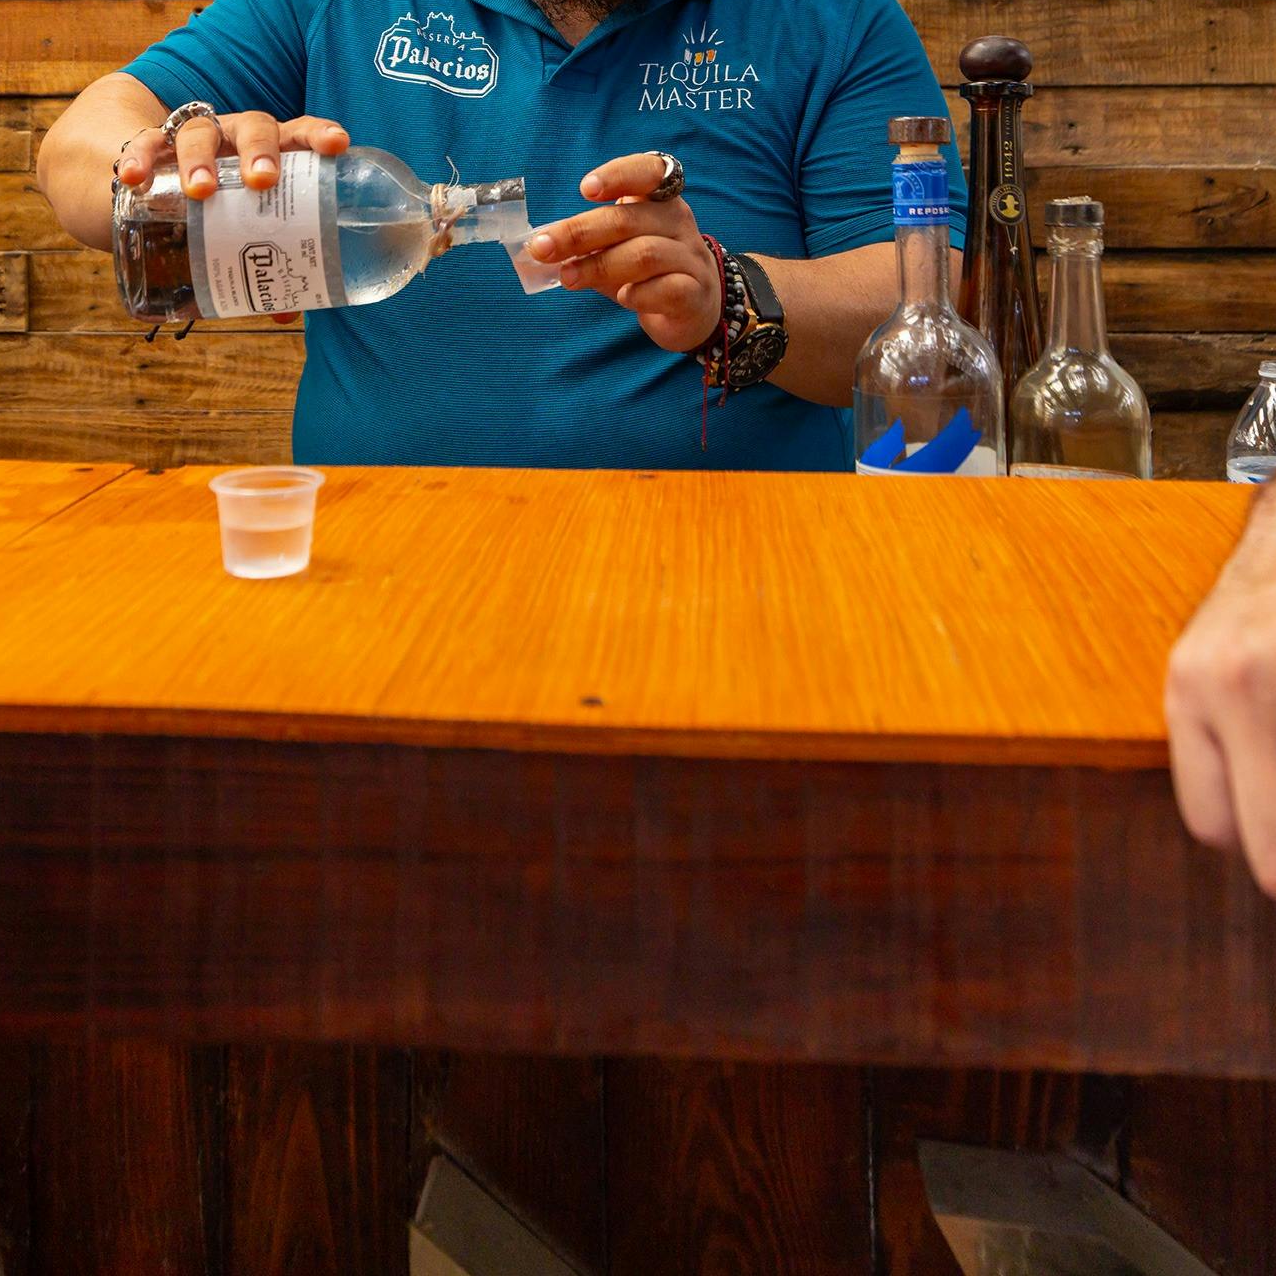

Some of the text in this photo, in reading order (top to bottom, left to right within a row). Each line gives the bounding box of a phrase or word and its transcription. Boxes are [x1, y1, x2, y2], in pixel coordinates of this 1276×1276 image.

[416, 27, 466, 51] RESERVA
[387, 35, 490, 81] Palacios
[638, 61, 761, 92] TEQUILA
[637, 86, 756, 111] MASTER
[1004, 140, 1014, 179] 1942
[247, 249, 277, 312] Palacios
